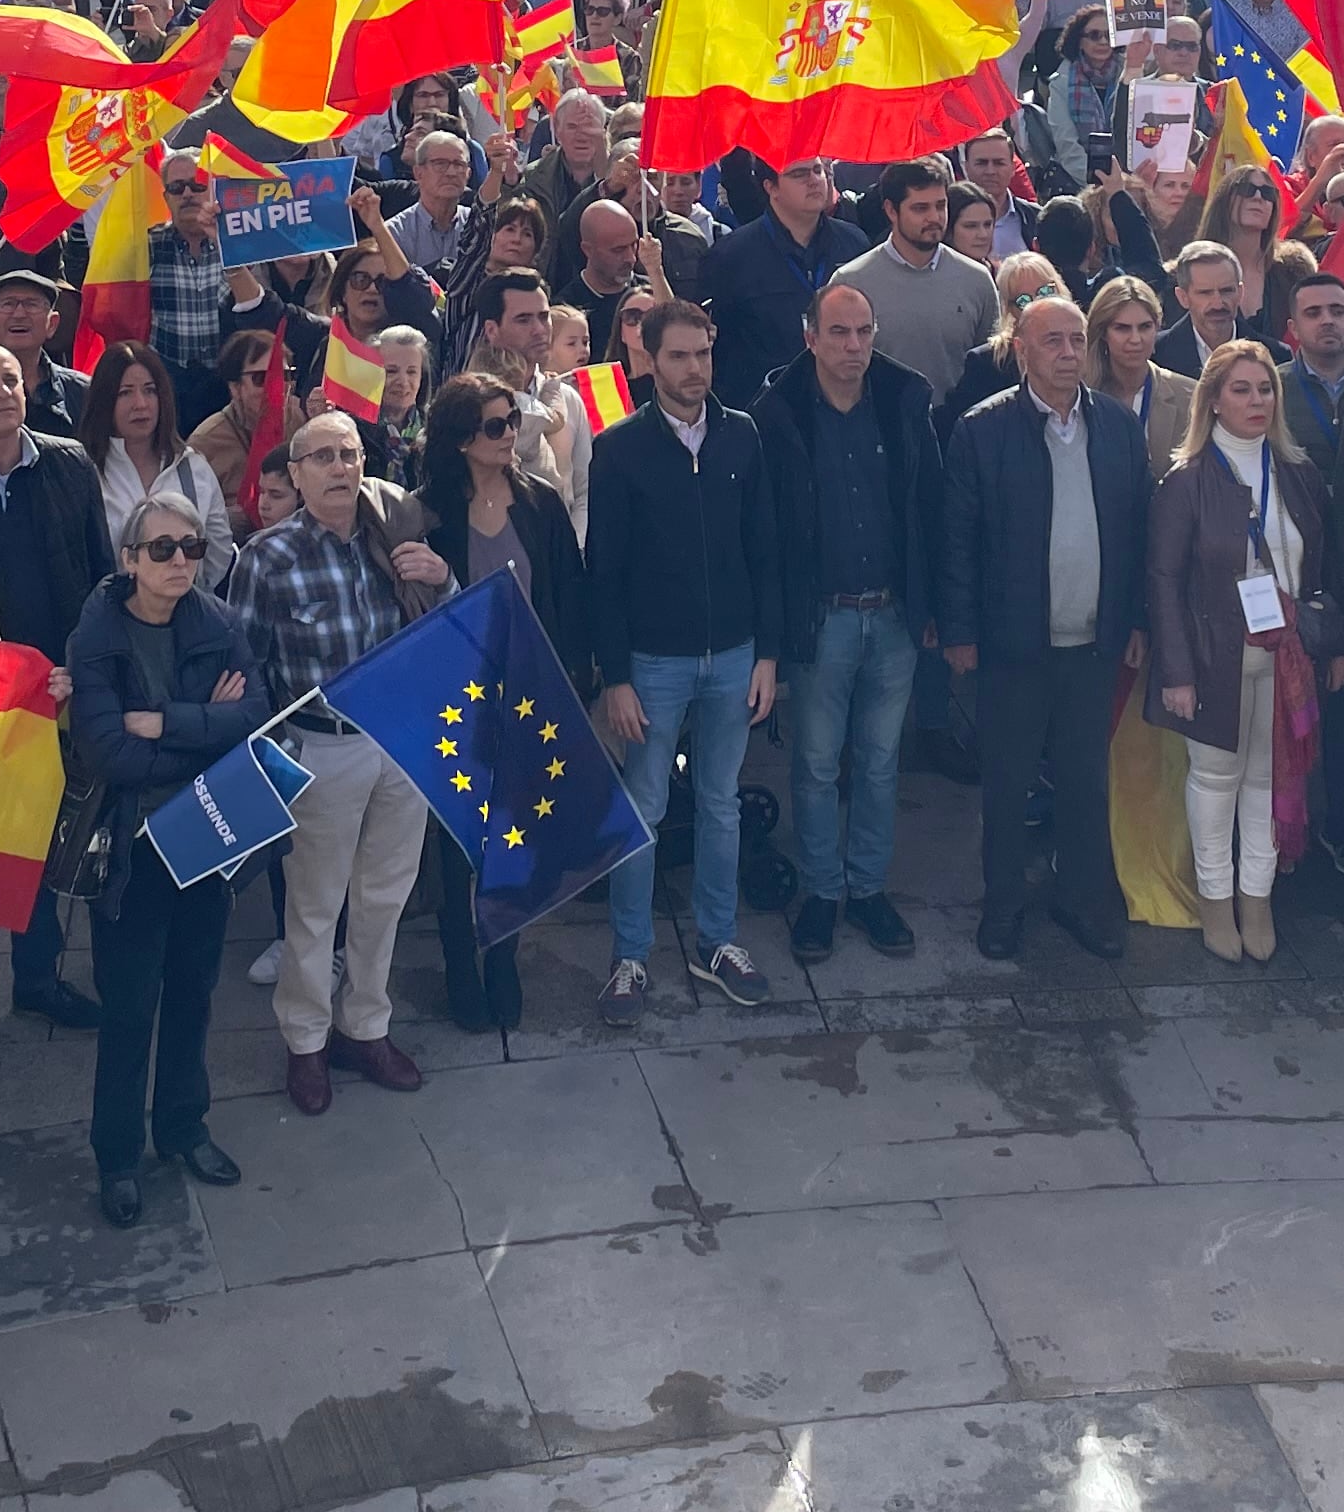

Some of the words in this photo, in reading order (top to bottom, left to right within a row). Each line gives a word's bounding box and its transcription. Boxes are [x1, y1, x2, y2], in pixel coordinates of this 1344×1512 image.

[223, 172, 336, 208] ESPAÑA
[225, 207, 264, 236] EN
[267, 199, 313, 230] PIE
